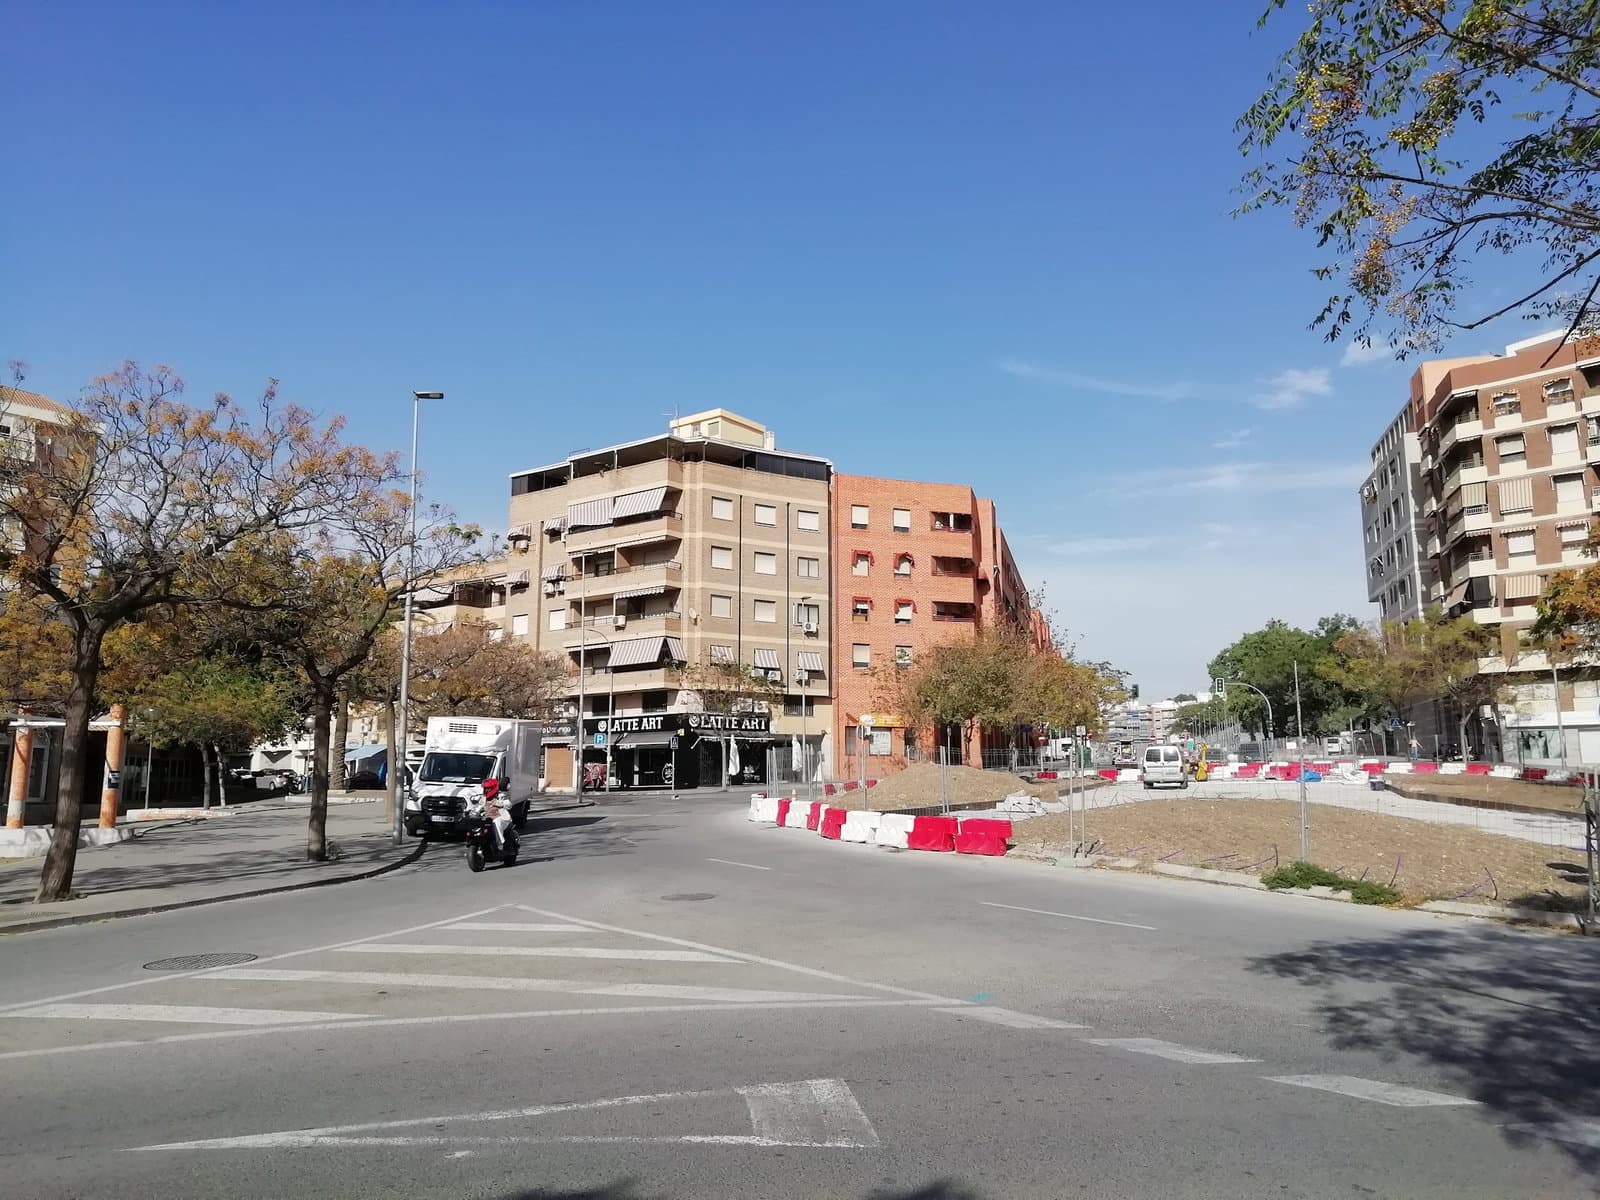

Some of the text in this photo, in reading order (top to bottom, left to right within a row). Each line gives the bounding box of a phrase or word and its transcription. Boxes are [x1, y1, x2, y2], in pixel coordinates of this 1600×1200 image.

[641, 716, 664, 730] ART
[741, 717, 768, 730] ART
[596, 734, 604, 744] P
